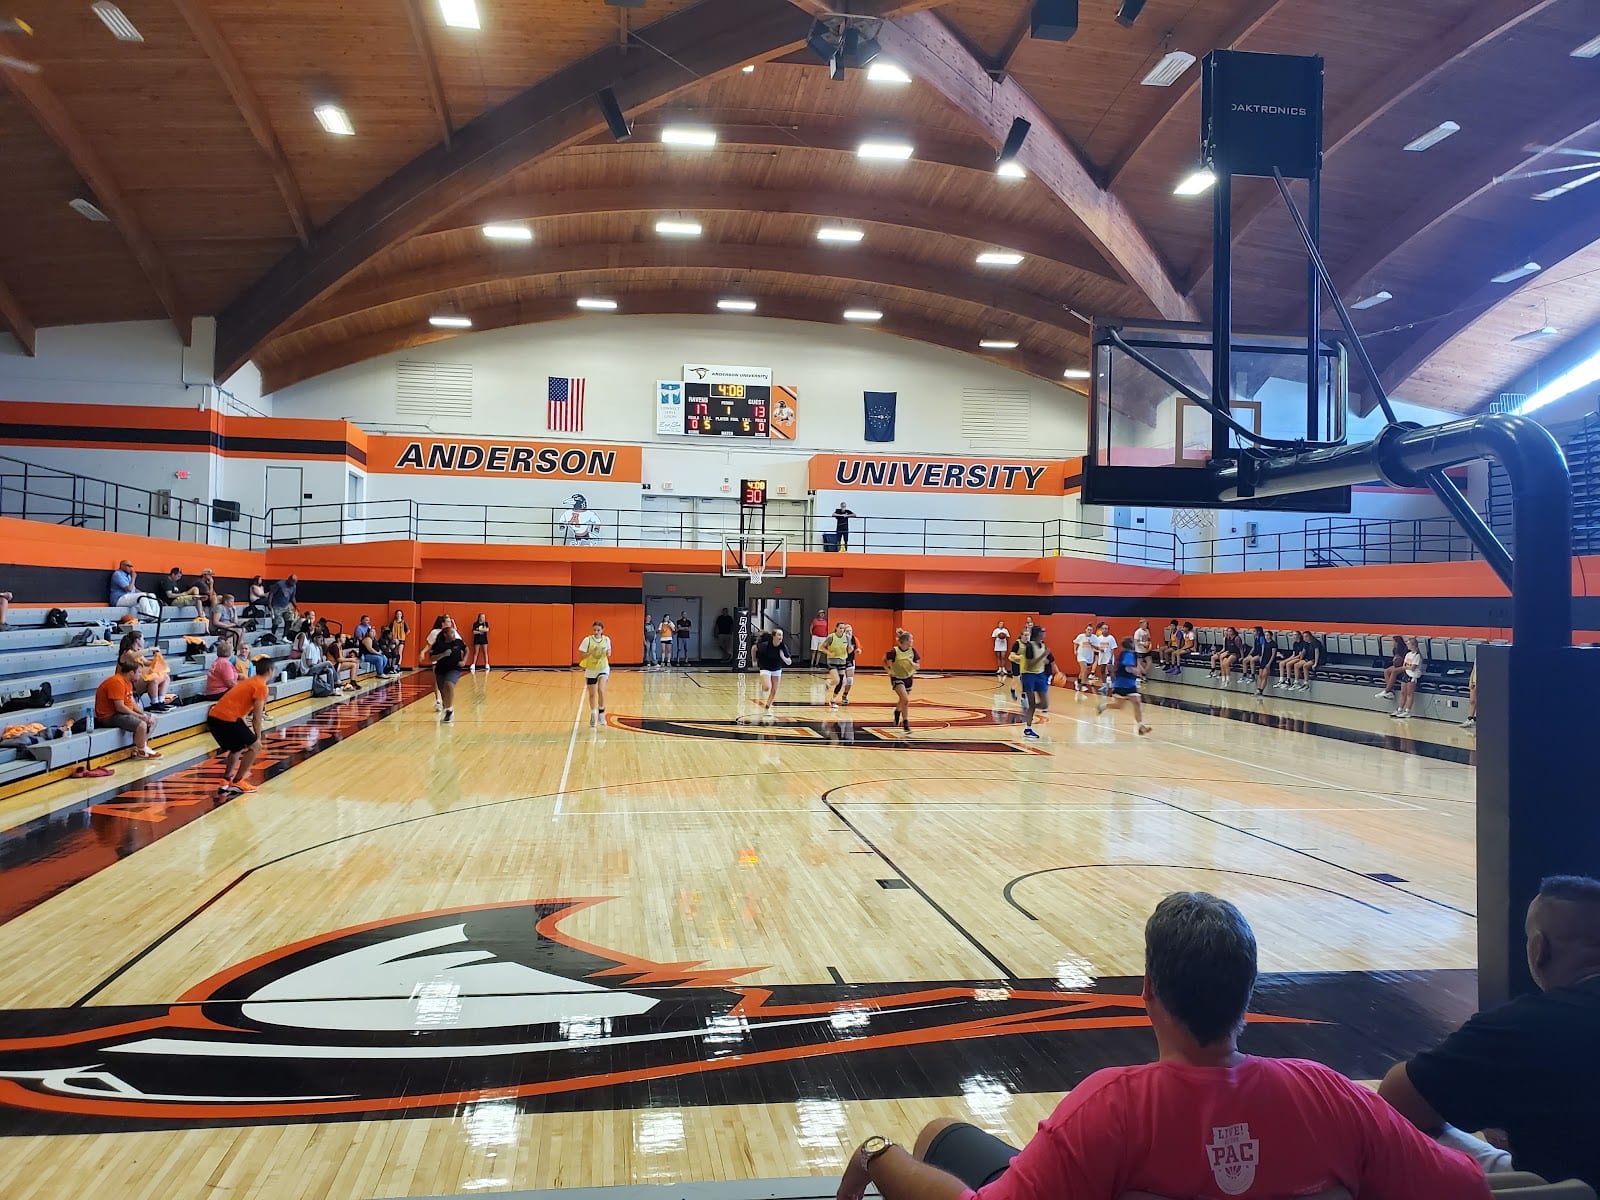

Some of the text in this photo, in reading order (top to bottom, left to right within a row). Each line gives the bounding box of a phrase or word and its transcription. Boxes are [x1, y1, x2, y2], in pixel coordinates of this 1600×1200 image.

[718, 385, 744, 397] 4:08
[696, 404, 708, 415] 17
[755, 406, 766, 417] 13
[692, 420, 698, 429] 0
[758, 422, 765, 431] 0
[395, 442, 617, 477] ANDERSON
[835, 459, 1049, 490] UNIVERSITY
[747, 481, 765, 490] 4:08
[746, 489, 762, 503] 30
[738, 616, 748, 668] RAVENS
[1218, 1125, 1244, 1139] LIVE!
[1212, 1143, 1254, 1166] PAC
